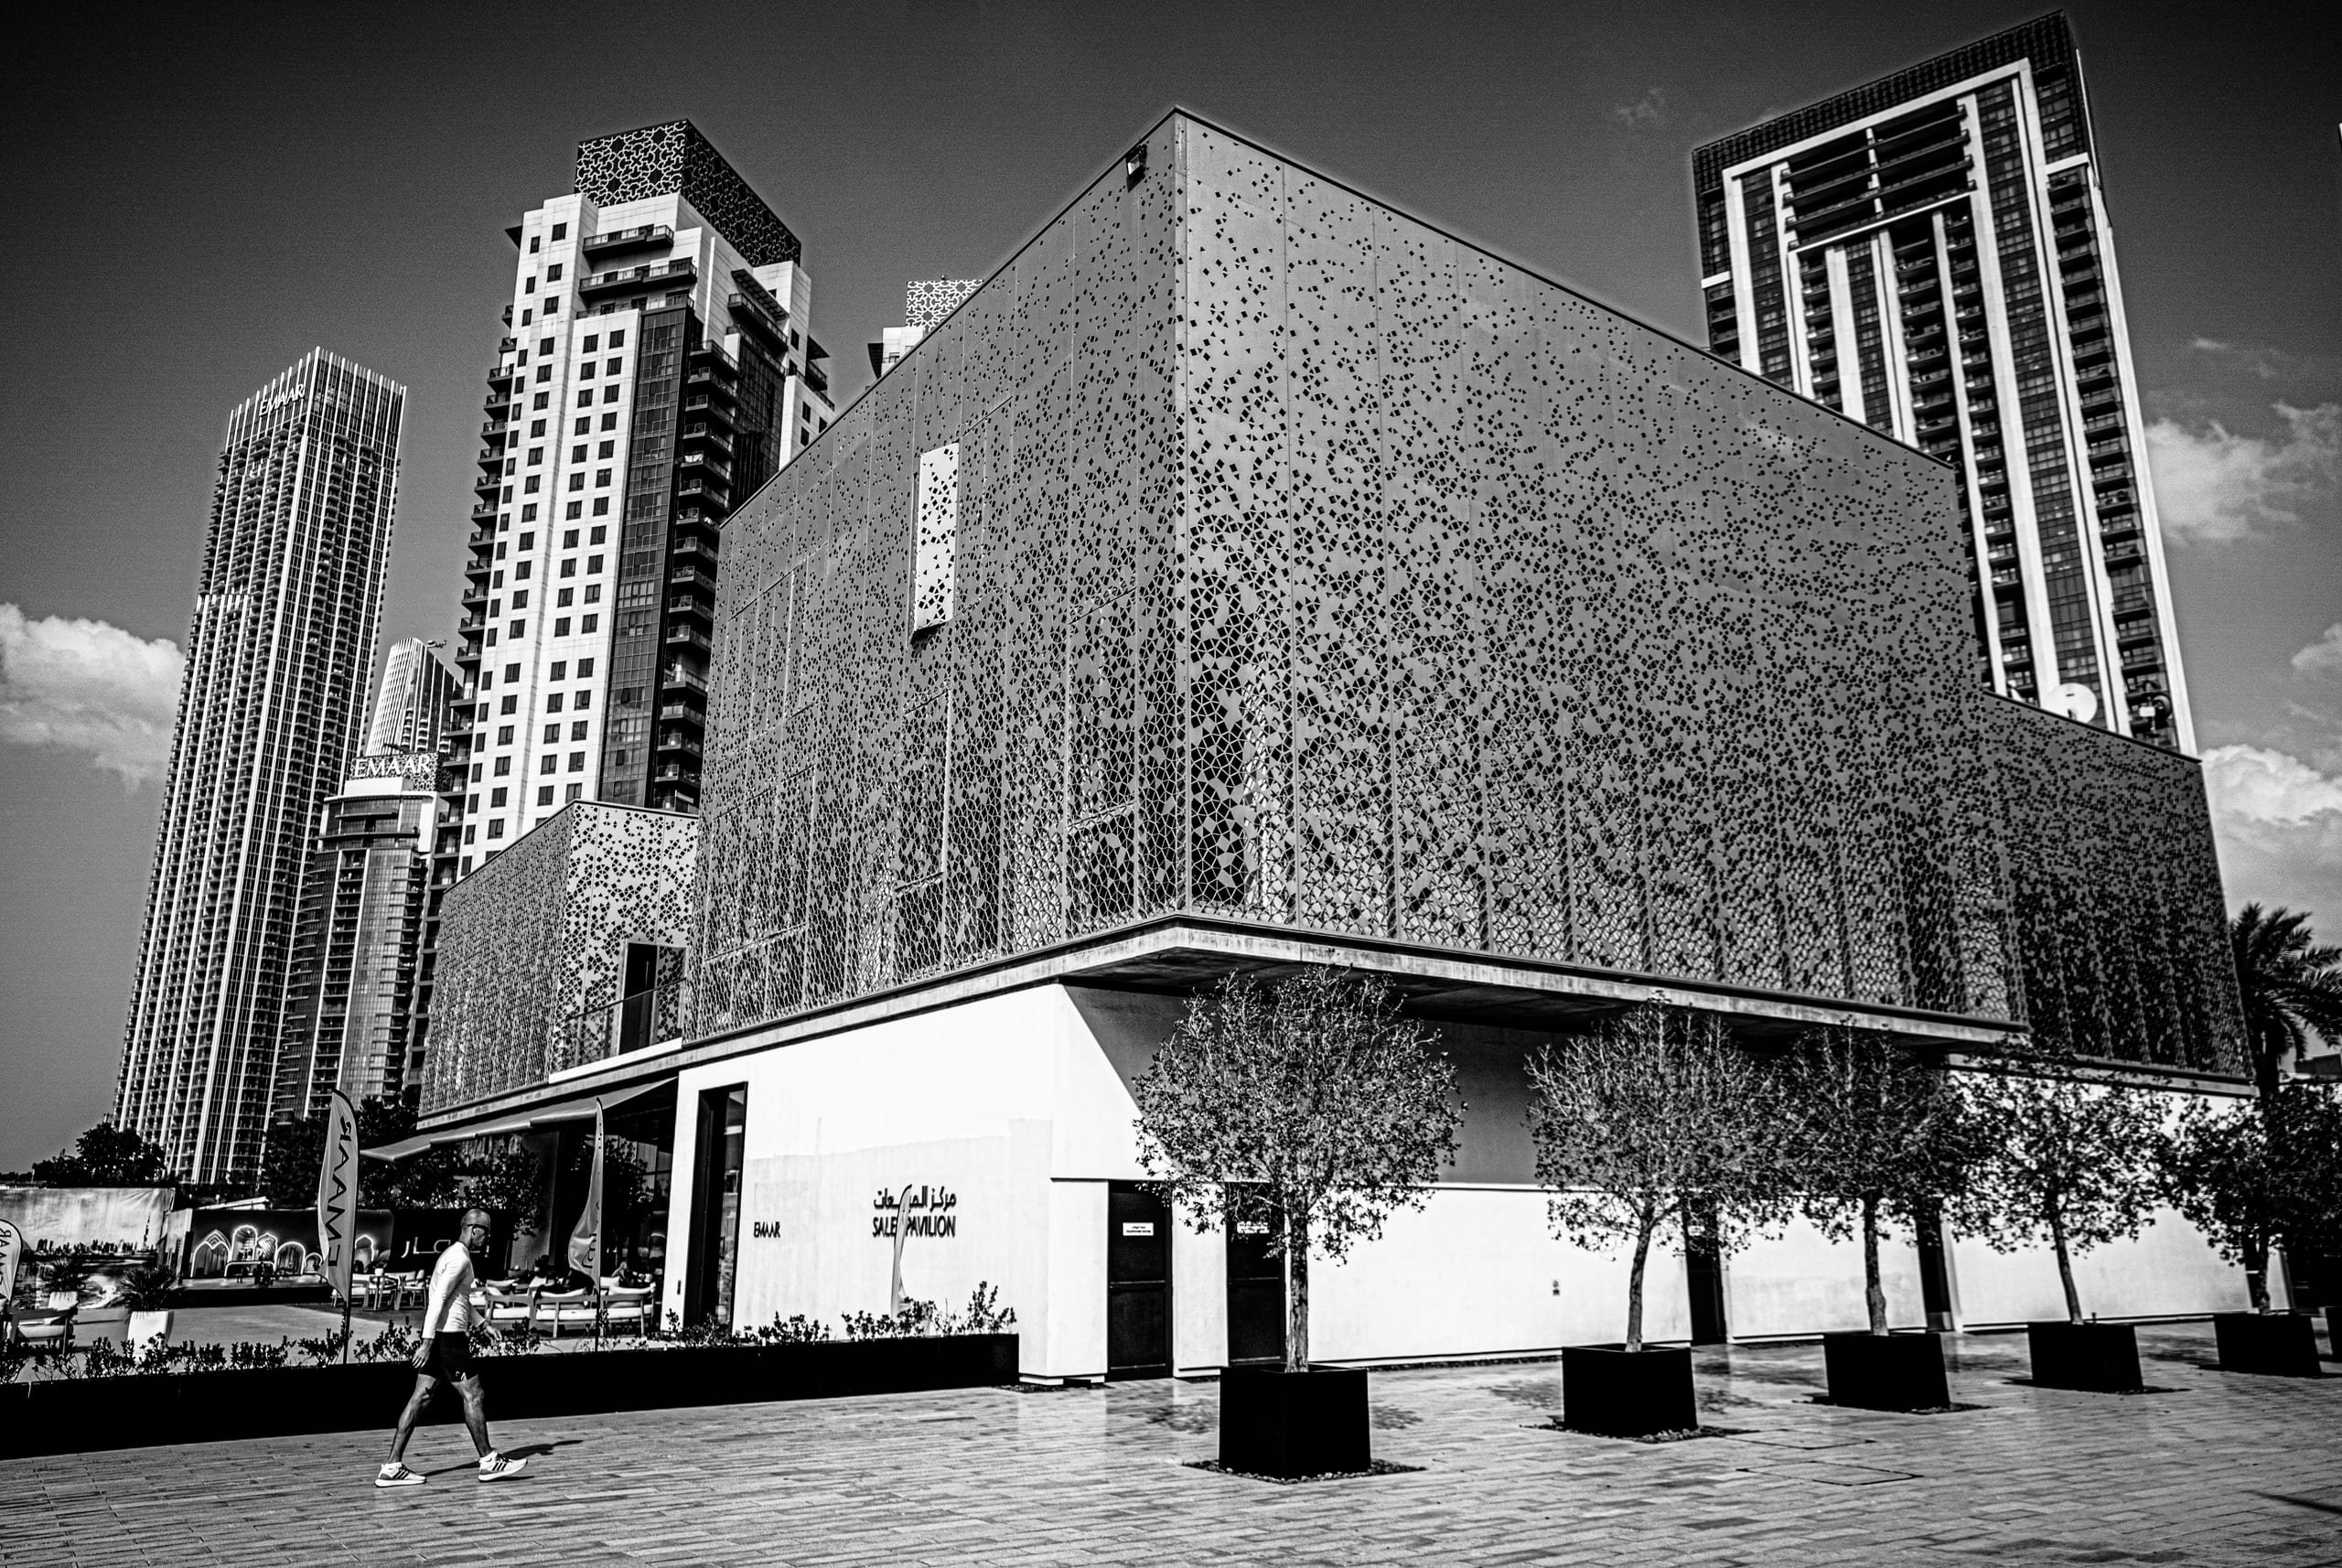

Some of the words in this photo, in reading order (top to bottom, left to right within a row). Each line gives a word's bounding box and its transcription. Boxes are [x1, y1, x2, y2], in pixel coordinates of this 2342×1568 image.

[259, 383, 305, 416] EMAAR
[354, 754, 431, 778] EMAAR
[929, 1186, 957, 1213] مركز
[753, 1221, 781, 1238] EMAAR
[872, 1217, 898, 1238] SALE
[905, 1215, 957, 1238] PAVILION
